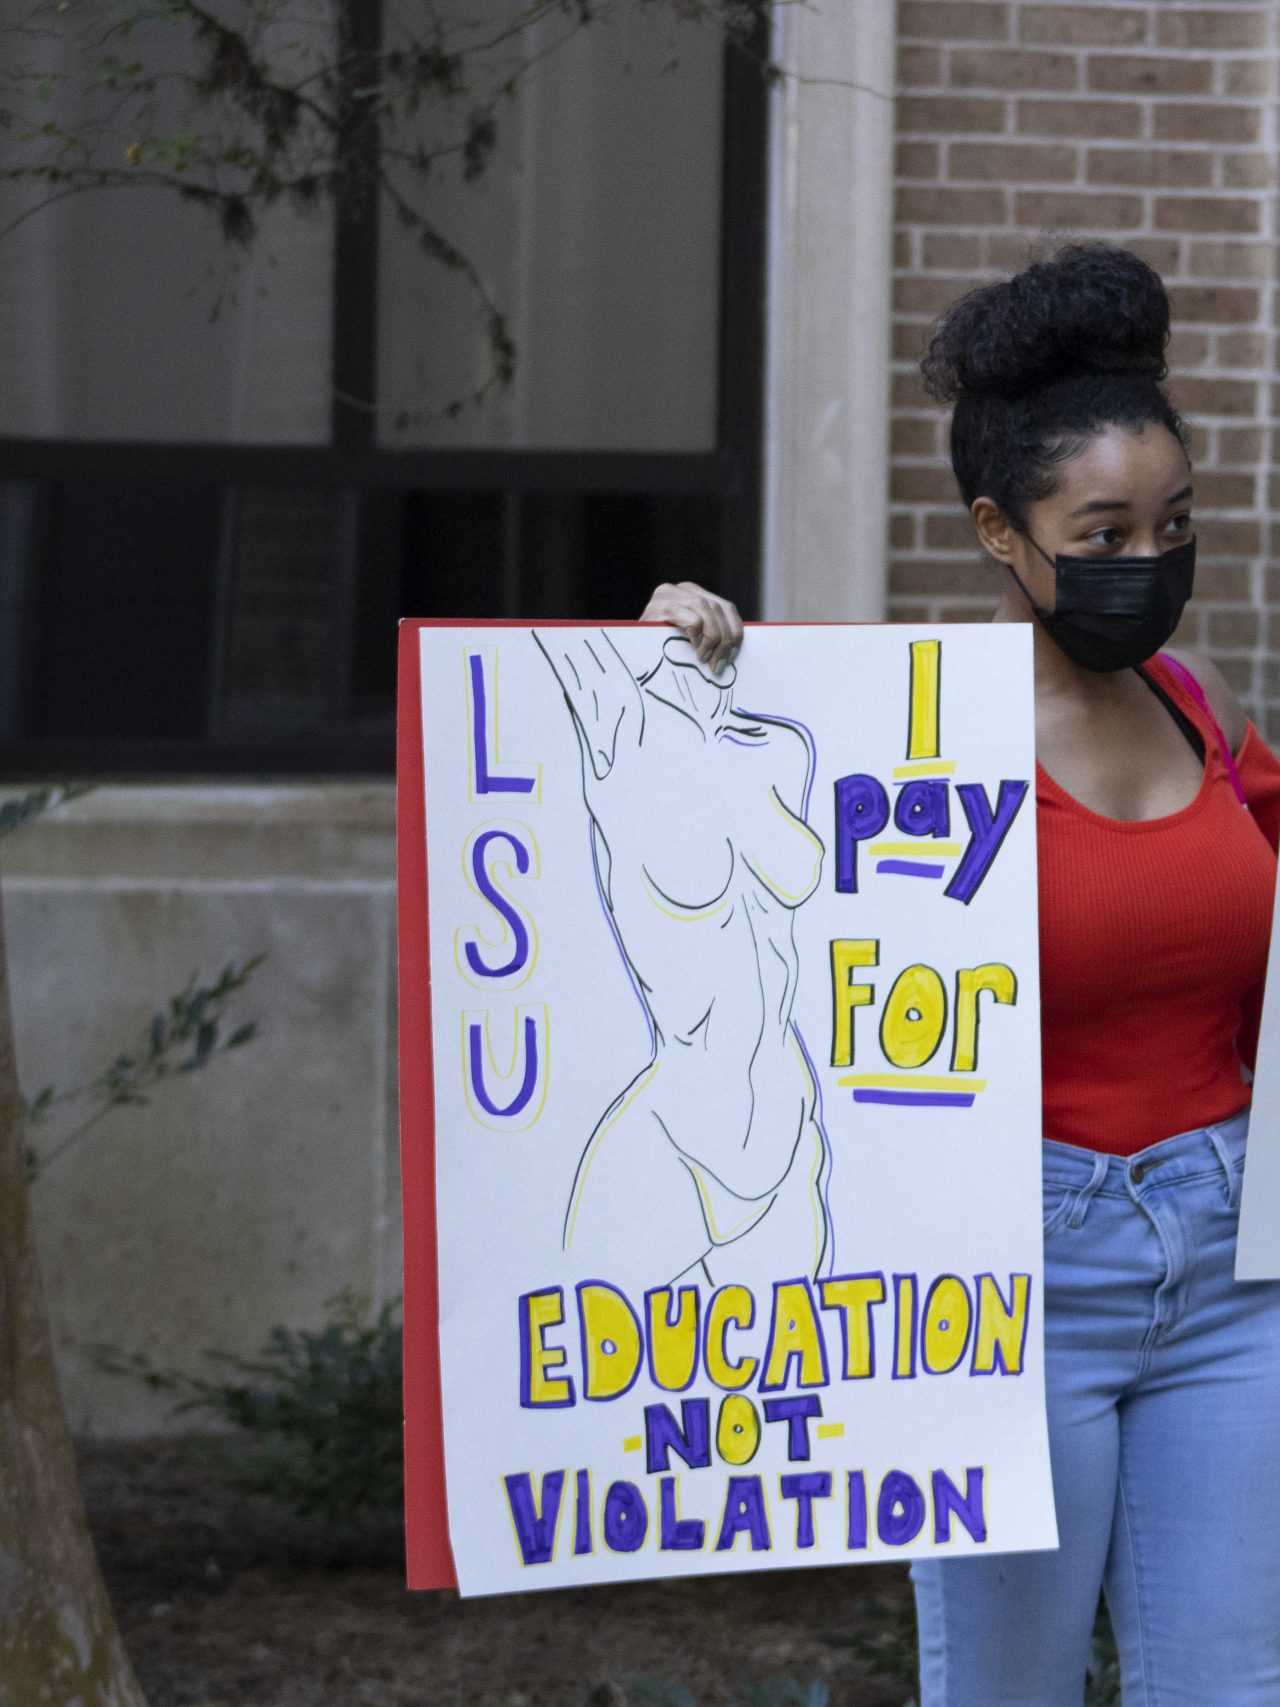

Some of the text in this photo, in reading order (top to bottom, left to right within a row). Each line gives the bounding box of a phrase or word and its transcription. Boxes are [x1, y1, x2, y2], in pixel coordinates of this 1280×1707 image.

[906, 639, 941, 760] I
[456, 647, 550, 1132] LSU
[833, 774, 1029, 905] pay
[830, 939, 1018, 1071] For
[518, 1271, 1032, 1408] EDUCATION
[504, 1466, 987, 1566] VIOLATION
